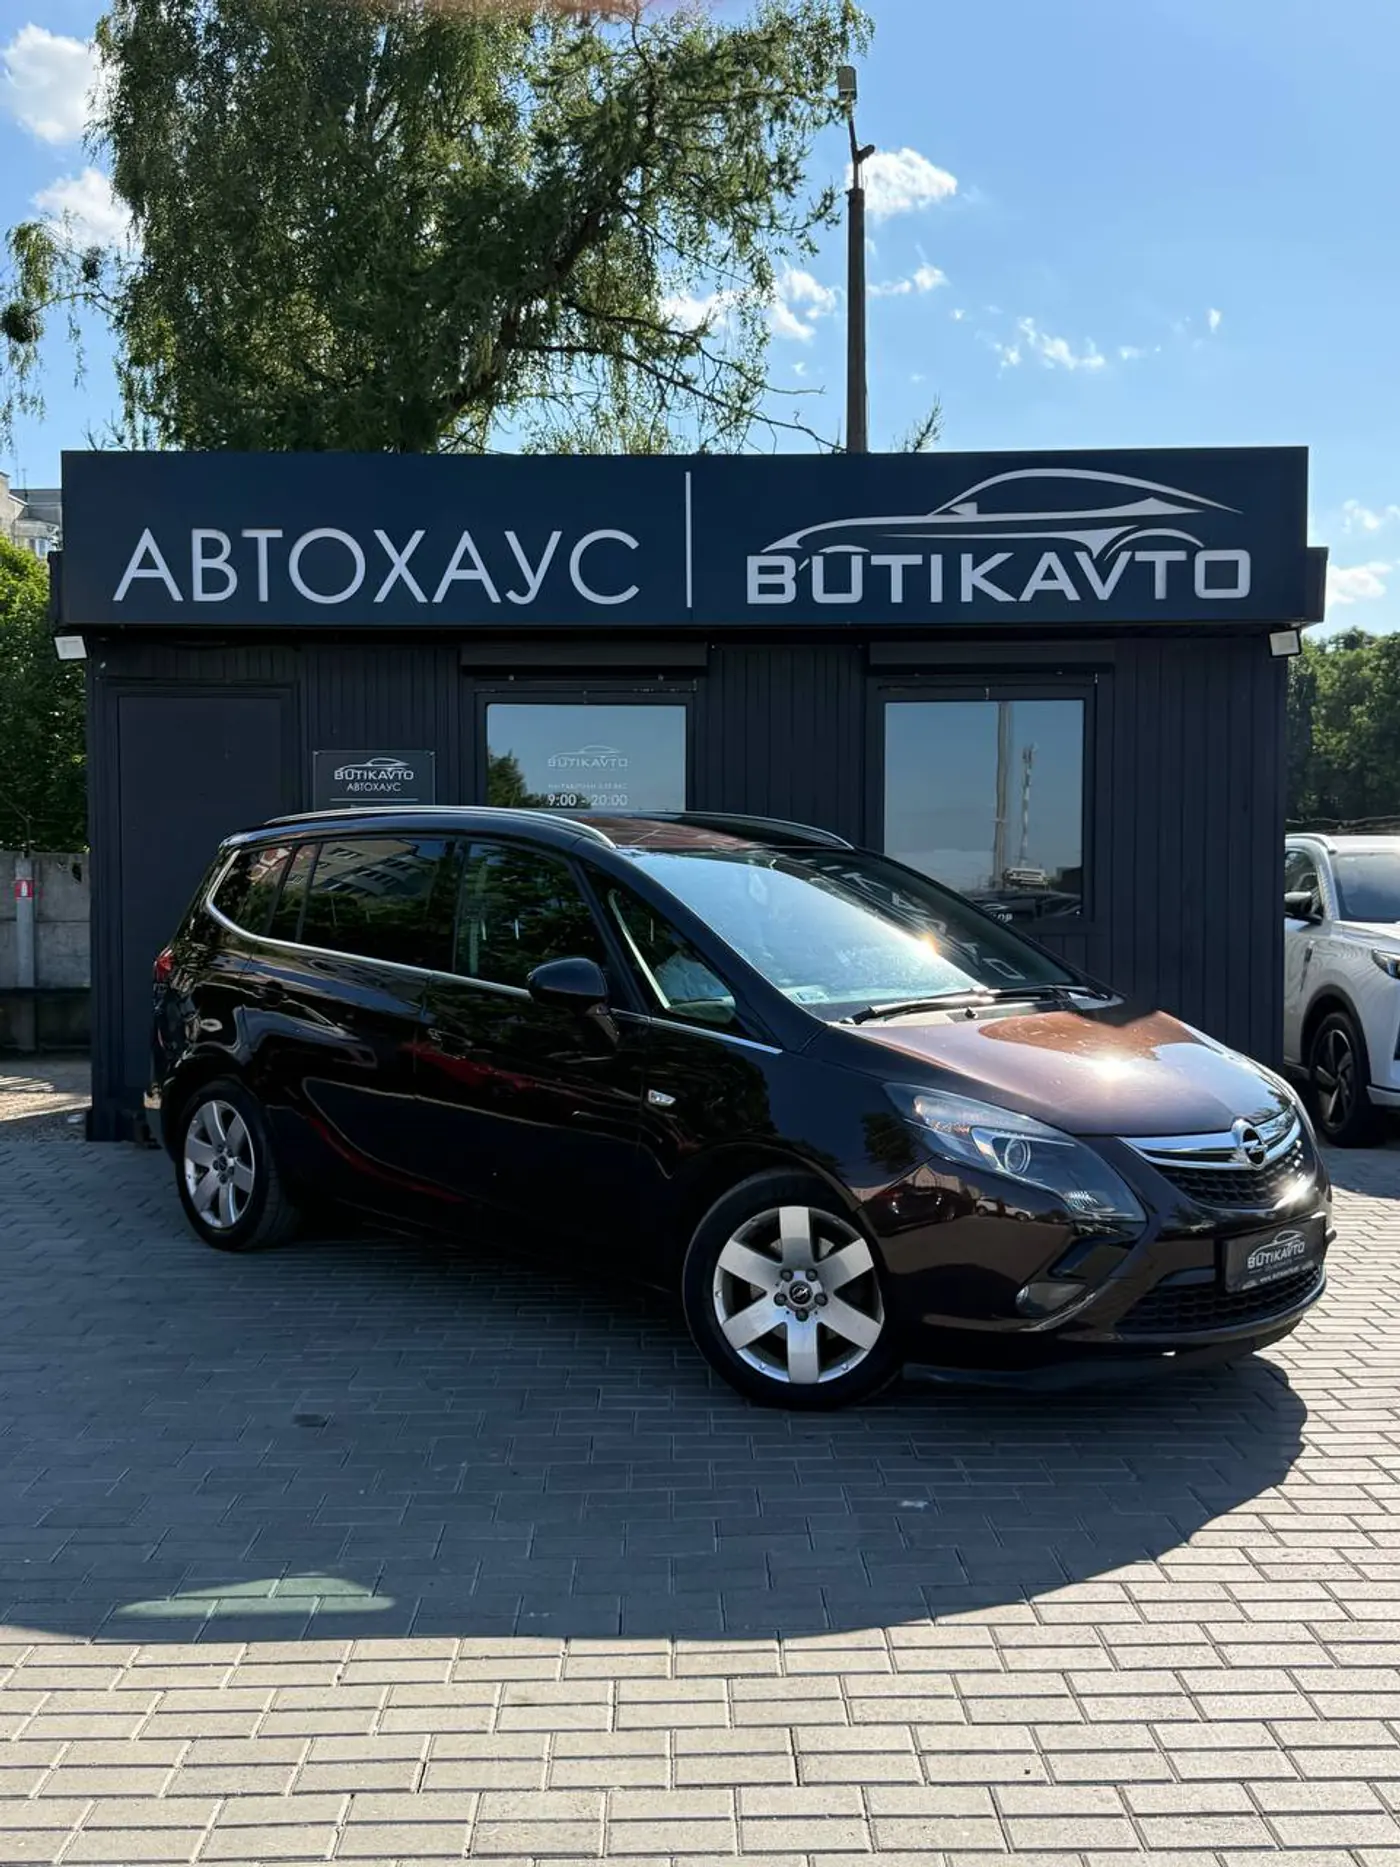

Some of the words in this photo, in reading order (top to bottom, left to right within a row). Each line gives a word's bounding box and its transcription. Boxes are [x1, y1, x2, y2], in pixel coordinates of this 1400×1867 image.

[112, 527, 640, 606] АВТОХАУС
[746, 548, 1252, 605] BUTIKAVTO
[547, 757, 629, 768] BUTIKAVTO
[333, 768, 415, 780] BUTIKAVTO
[346, 782, 402, 792] АВТОХАУС
[547, 793, 577, 807] 9:00
[590, 793, 628, 807] 20:00
[1247, 1241, 1305, 1269] BUTIKAVTO
